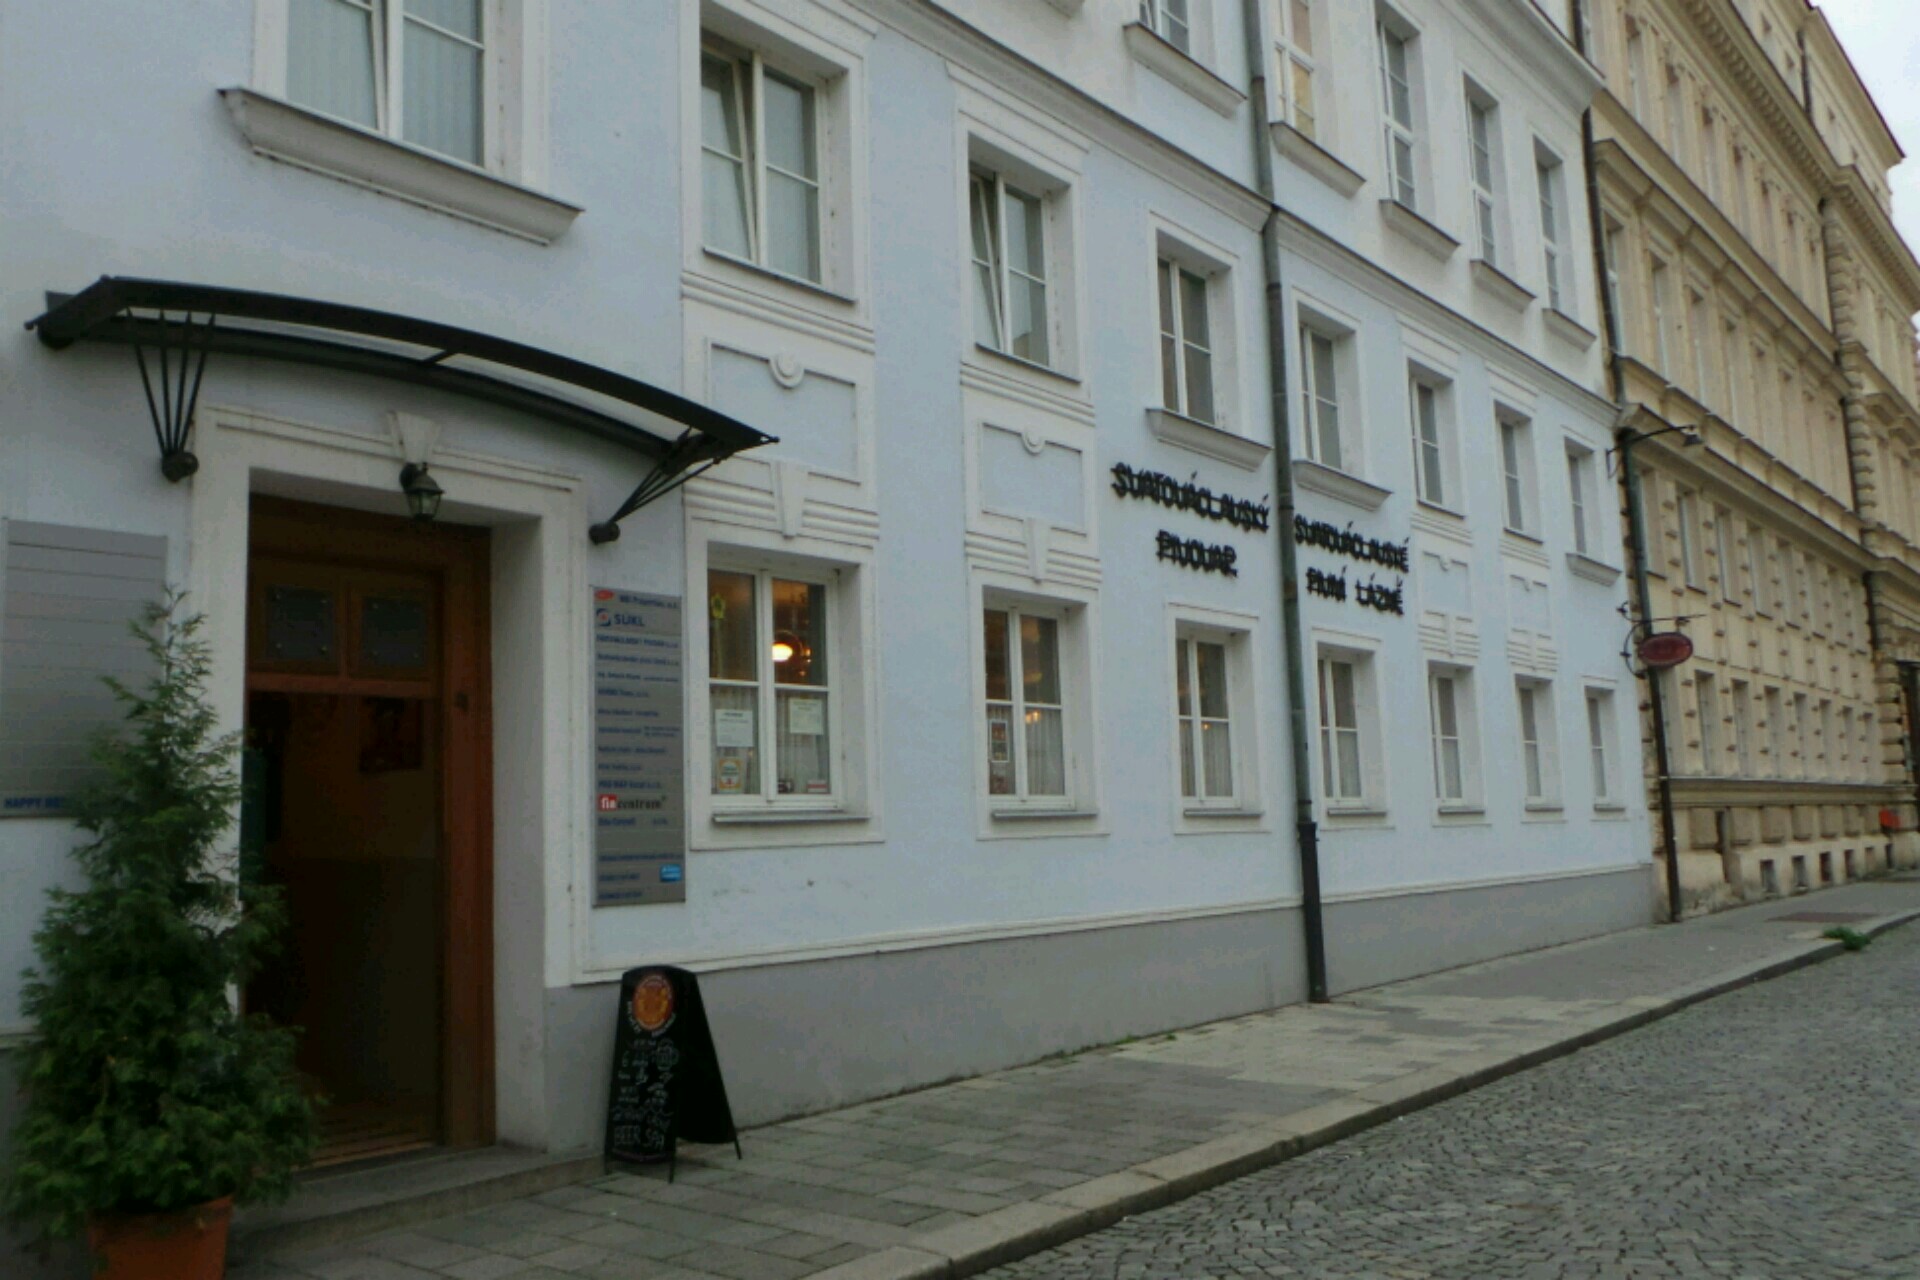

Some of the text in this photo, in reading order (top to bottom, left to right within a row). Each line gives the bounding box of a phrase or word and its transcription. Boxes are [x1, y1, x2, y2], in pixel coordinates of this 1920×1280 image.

[1156, 529, 1238, 577] PIVOVAR
[1306, 566, 1403, 615] PIVNÍ LÁZNĚ
